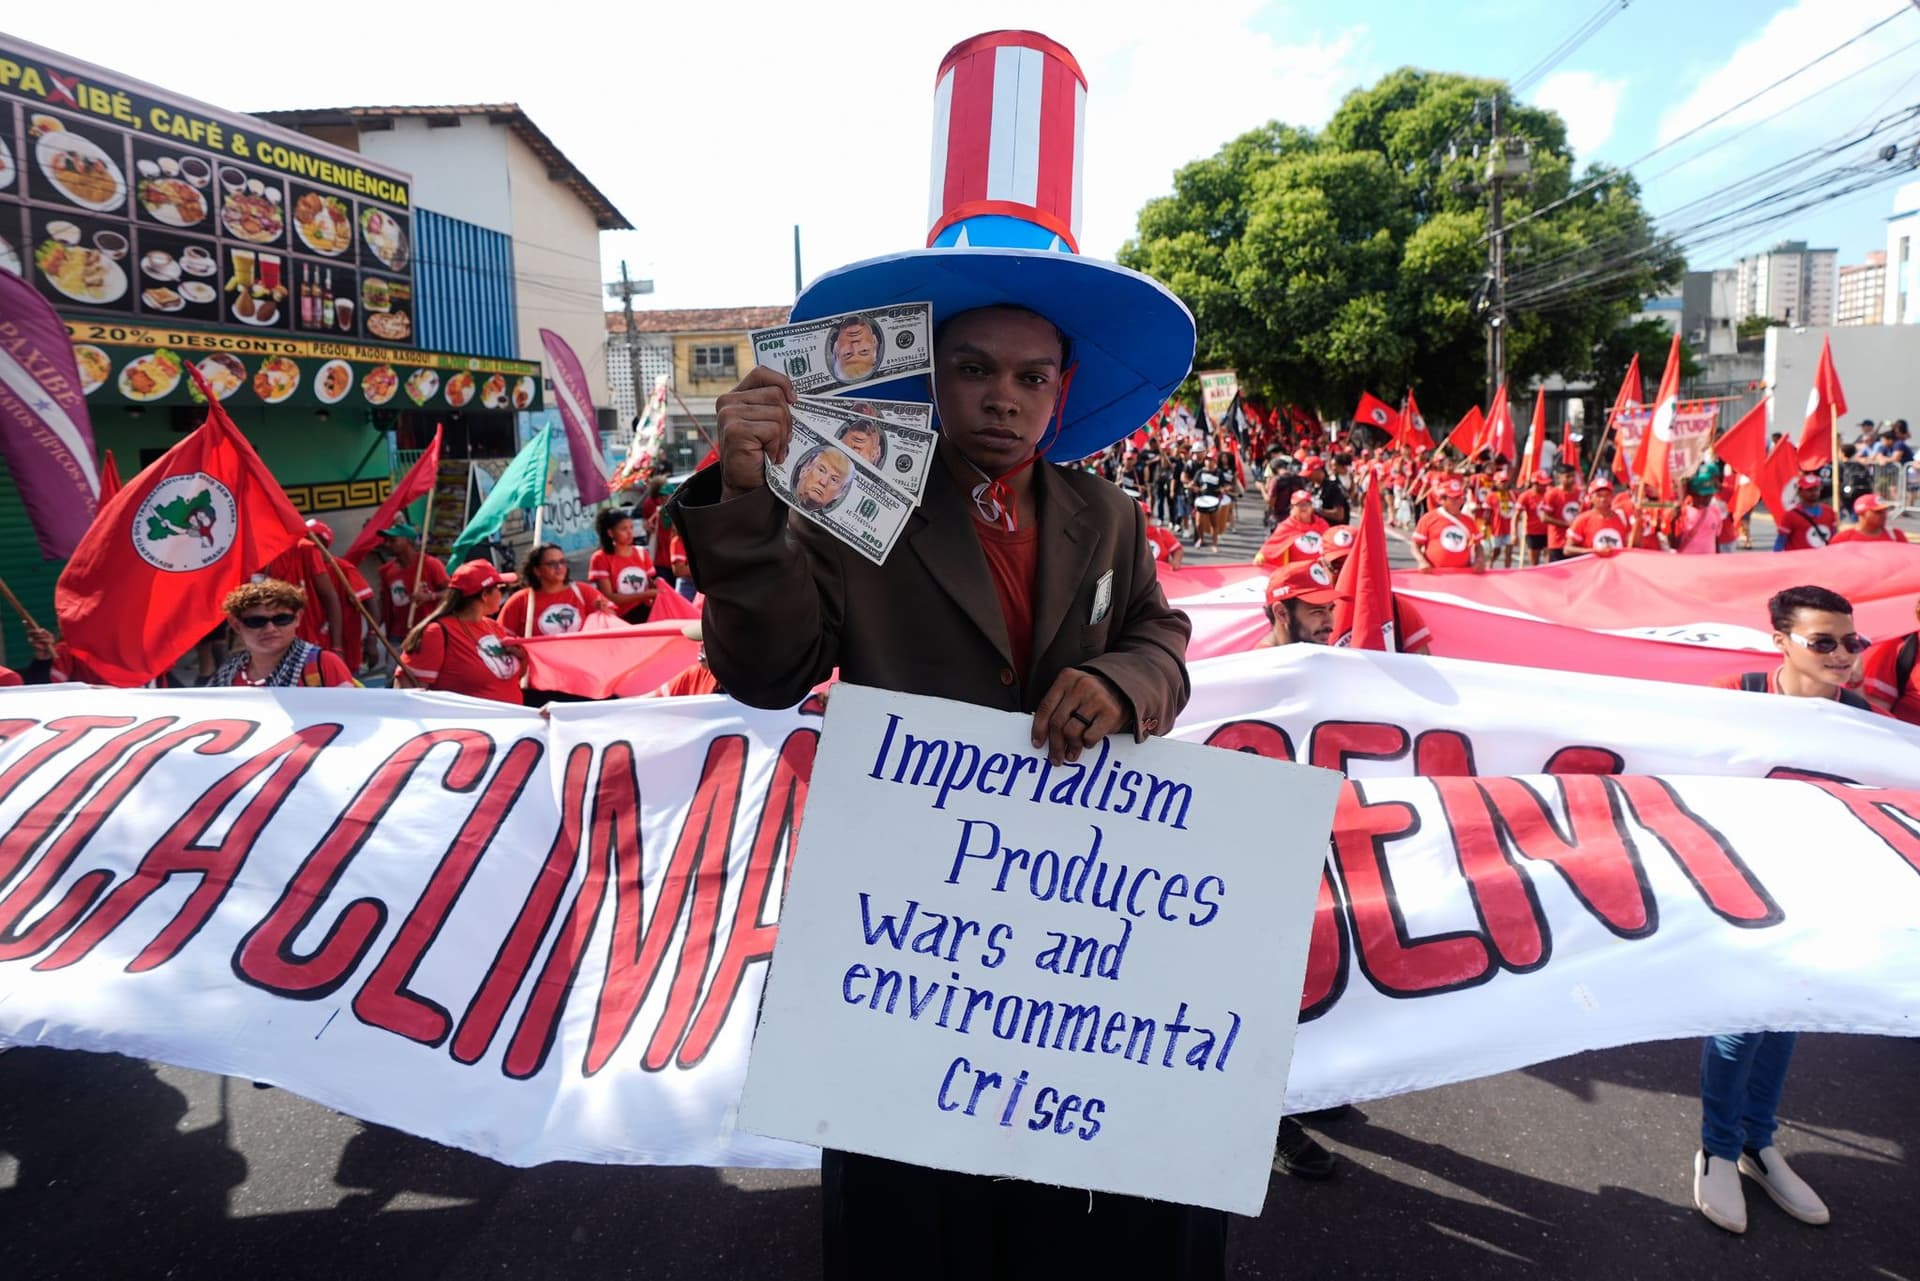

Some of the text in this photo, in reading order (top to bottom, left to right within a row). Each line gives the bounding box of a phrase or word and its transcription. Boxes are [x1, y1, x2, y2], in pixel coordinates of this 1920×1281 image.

[150, 107, 224, 150] CAFÉ
[231, 133, 250, 157] &
[256, 141, 408, 206] CONVENIÊNCIA
[89, 326, 155, 344] 20%
[168, 333, 303, 354] DESCONTO.
[759, 339, 786, 352] 100
[860, 530, 884, 550] 100
[868, 713, 1193, 830] Imperialism
[944, 818, 1225, 927] Produces
[858, 892, 1131, 980] Wars and
[842, 962, 1241, 1072] environmental
